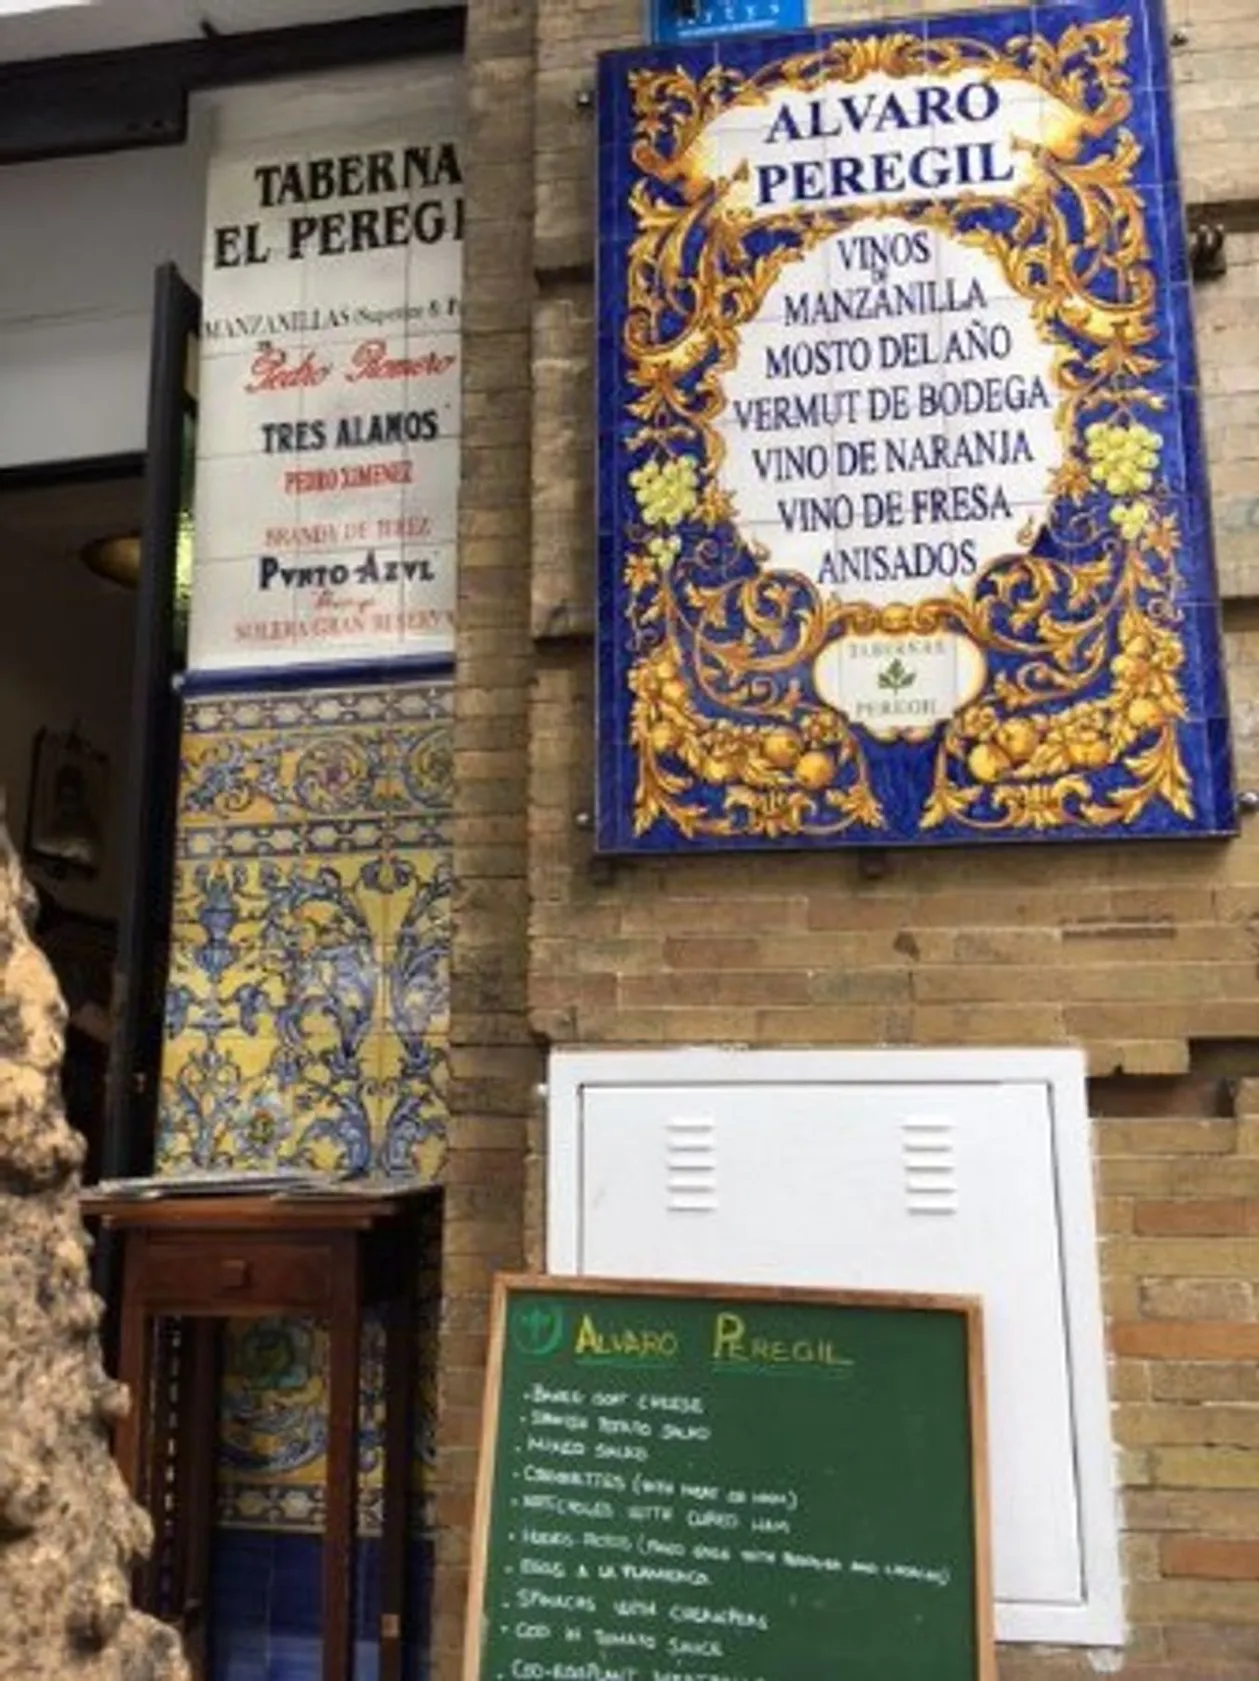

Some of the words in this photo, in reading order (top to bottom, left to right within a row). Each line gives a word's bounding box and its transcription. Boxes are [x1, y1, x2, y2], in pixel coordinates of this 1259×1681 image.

[764, 80, 1000, 144] ALVARO
[254, 142, 462, 208] TABERNA
[755, 142, 1014, 205] PEREGIL
[213, 222, 271, 269] EL
[837, 229, 931, 271] VINOS
[784, 277, 987, 327] MANZANILLA
[765, 336, 872, 380] MOSTO
[878, 332, 939, 369] DEL
[941, 318, 1012, 364] AÑO
[733, 387, 861, 432] VERMUT
[868, 385, 911, 421] DE
[917, 374, 1051, 416] BODEGA
[261, 419, 327, 453] TRES
[335, 410, 439, 448] ALAMOS
[751, 444, 829, 482] VINO
[836, 440, 878, 477] DE
[885, 429, 1037, 473] NARANJA
[283, 468, 338, 494] PEDRO
[777, 494, 855, 534] VINO
[862, 490, 904, 530] DE
[910, 483, 1013, 525] FRESA
[817, 538, 978, 585] ANISADOS
[573, 1312, 679, 1357] ALVARO
[712, 1310, 857, 1366] PEREGIL
